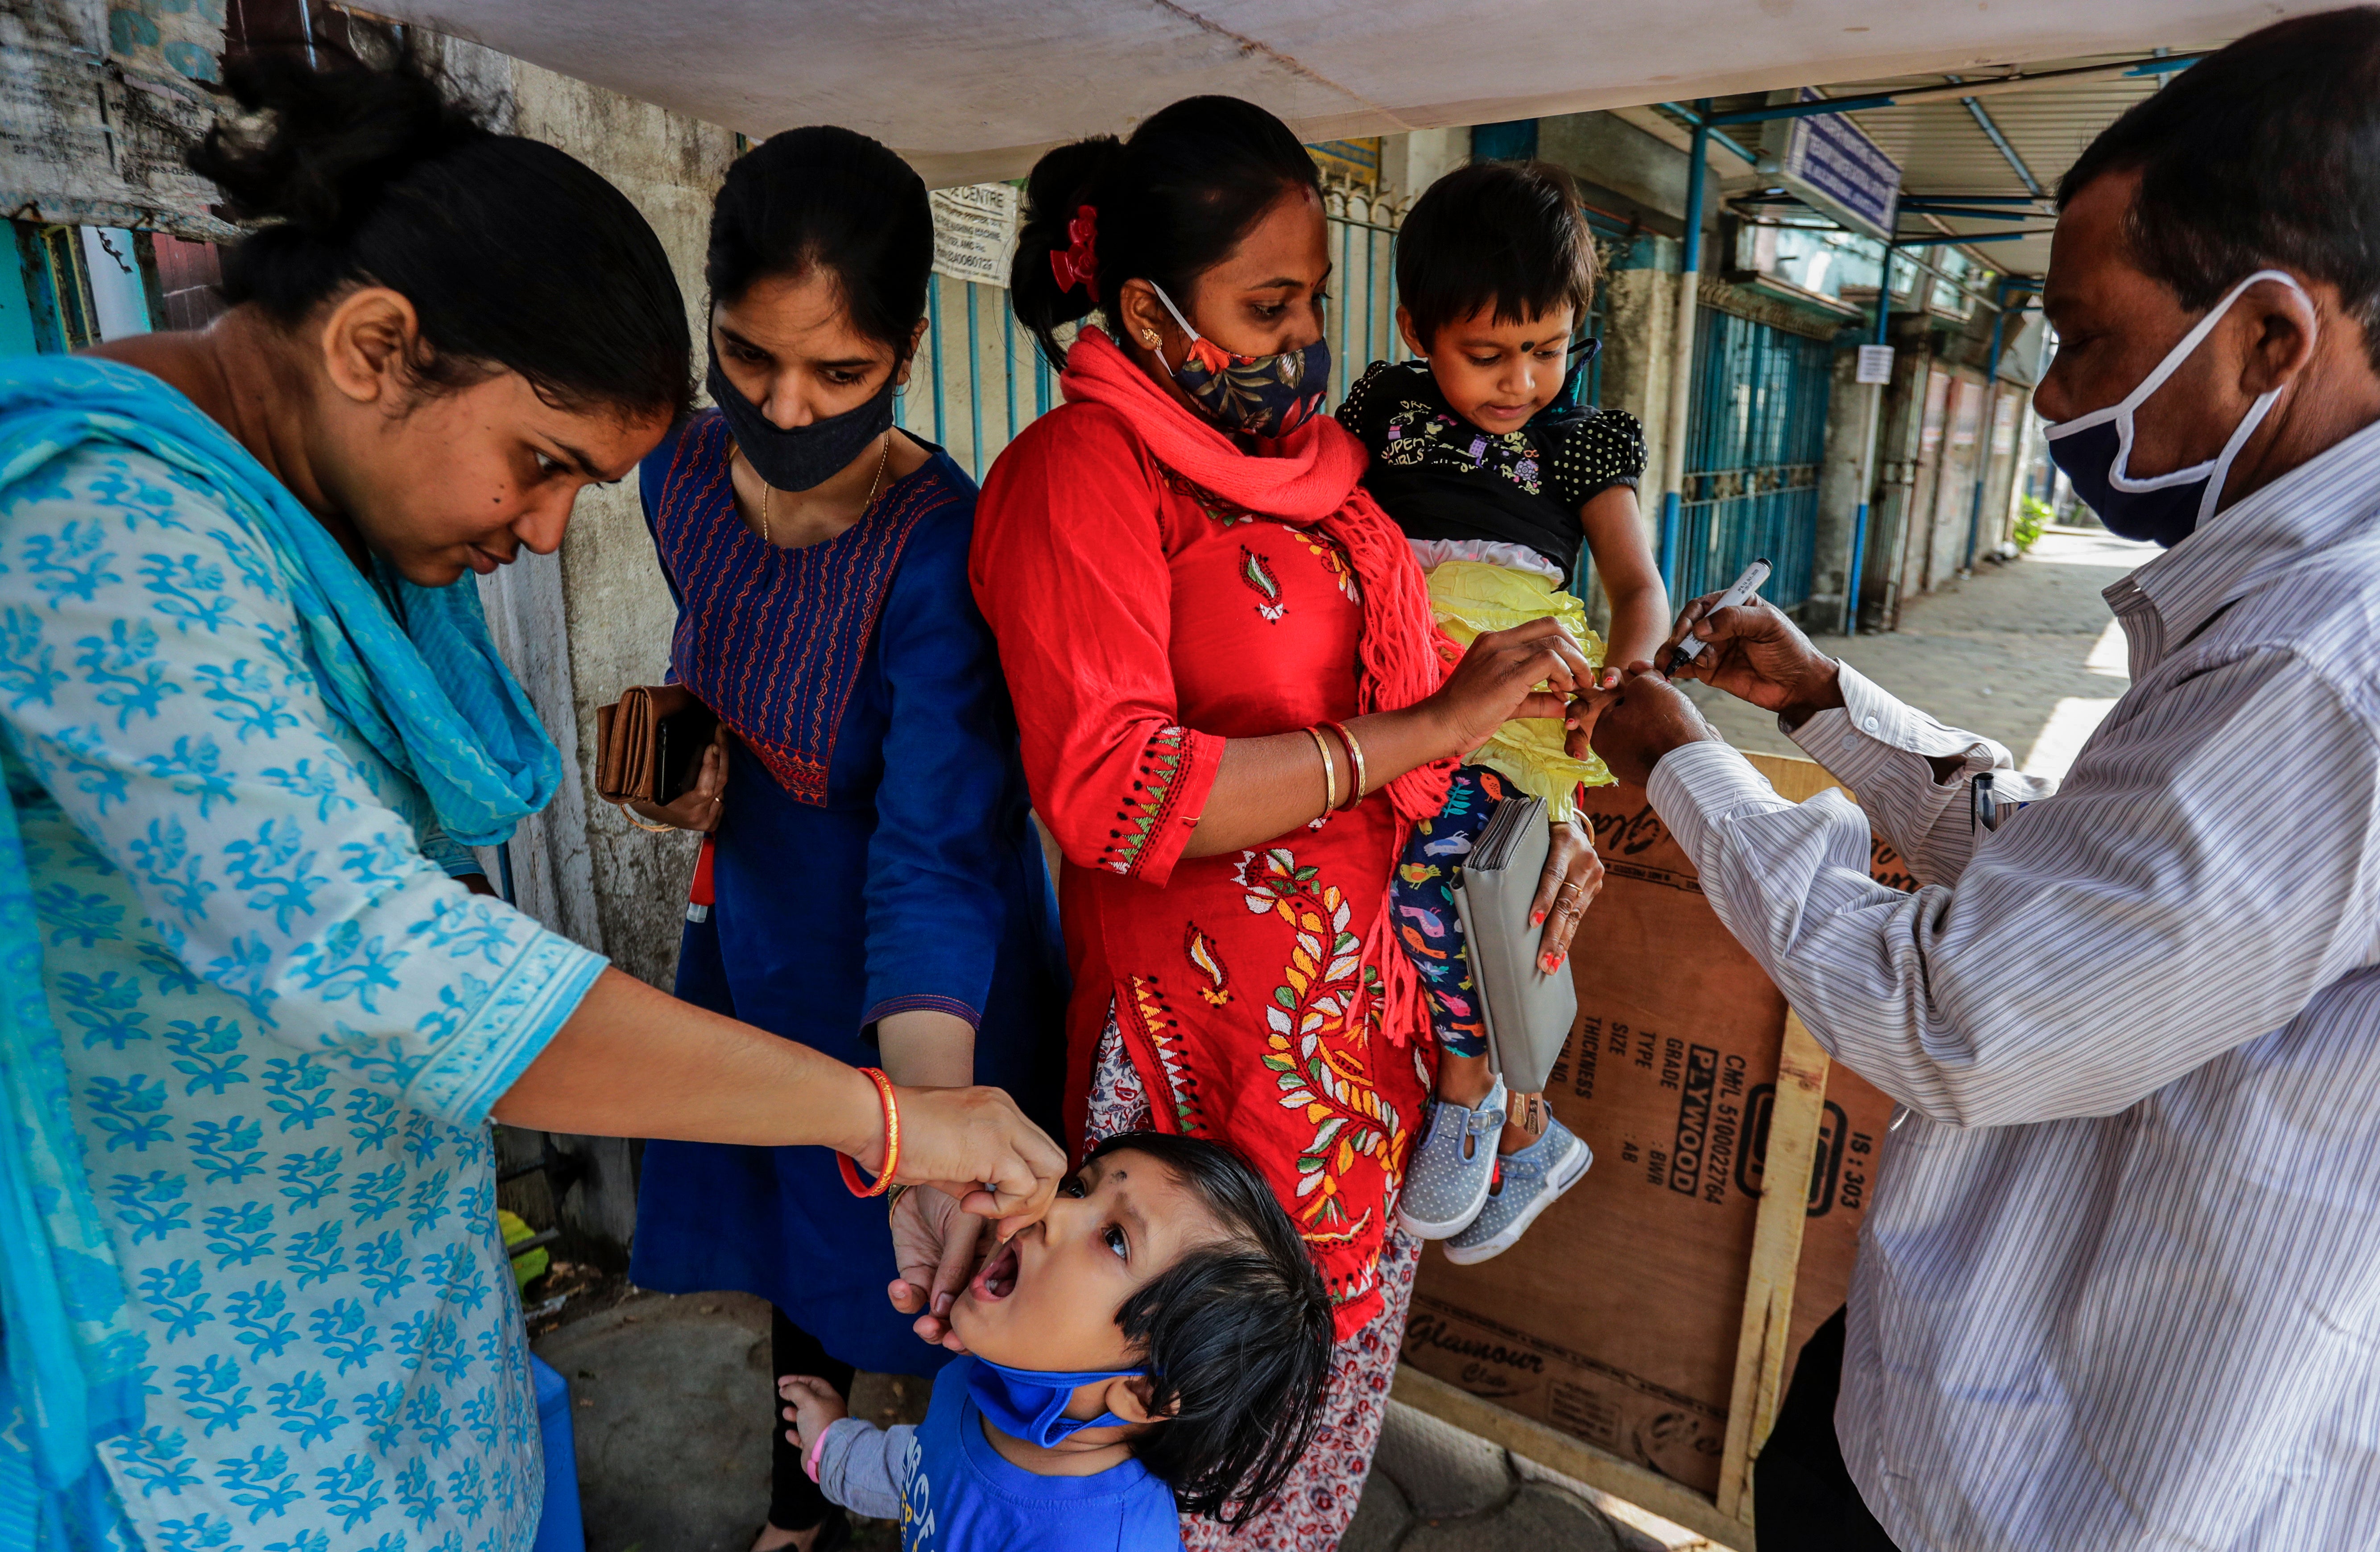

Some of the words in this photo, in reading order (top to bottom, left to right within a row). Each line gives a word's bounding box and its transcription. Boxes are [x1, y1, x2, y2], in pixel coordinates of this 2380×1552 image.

[962, 186, 1004, 208] CENTRE
[1590, 805, 1660, 855] Gla
[1575, 1016, 1602, 1099] THICKNESS
[1608, 1023, 1629, 1056] SIZE
[1635, 1031, 1656, 1070] TYPE
[1660, 1038, 1684, 1091] GRADE
[1718, 1055, 1747, 1098] CM/L
[1672, 1050, 1715, 1193] PLYWOOD
[1622, 1141, 1639, 1163] AB
[1704, 1104, 1738, 1205] 5100022764
[1851, 1132, 1872, 1154] IS
[1647, 1150, 1666, 1186] BWR
[1840, 1171, 1865, 1209] 303
[1407, 1314, 1545, 1375] Glamour
